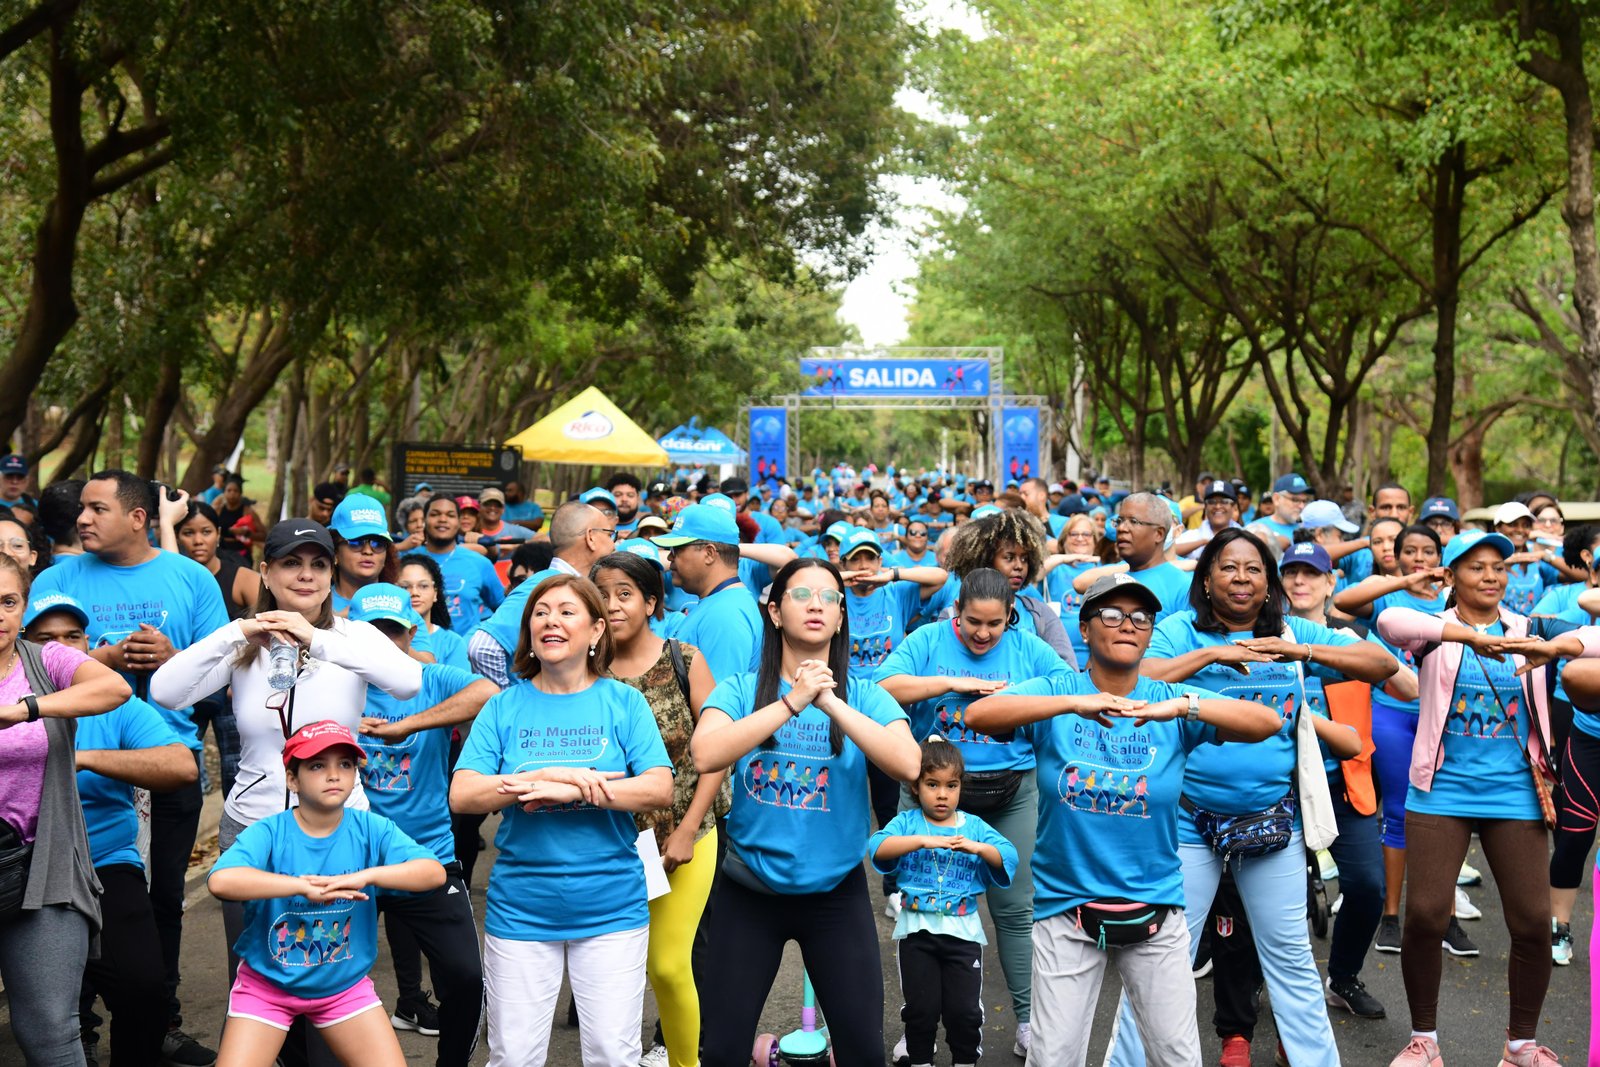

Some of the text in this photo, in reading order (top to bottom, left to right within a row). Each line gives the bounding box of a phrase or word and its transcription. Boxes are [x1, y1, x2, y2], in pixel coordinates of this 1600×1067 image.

[849, 367, 936, 388] SALIDA
[570, 422, 606, 433] Rico
[660, 437, 725, 451] dasani
[93, 600, 164, 613] Día Mundial
[96, 610, 161, 622] de la Salud
[937, 664, 1011, 680] Día Mundial
[519, 725, 604, 739] Día Mundial
[780, 728, 828, 743] la Salu
[1074, 722, 1151, 743] Día Mundial
[521, 736, 600, 749] de la Salud
[806, 744, 827, 753] 2025
[1074, 737, 1149, 756] de la Salud
[1086, 752, 1096, 760] de
[1121, 757, 1142, 765] 2025
[924, 851, 977, 870] Mundial
[901, 860, 972, 882] de la Salud
[907, 874, 913, 882] 7
[913, 875, 921, 883] de
